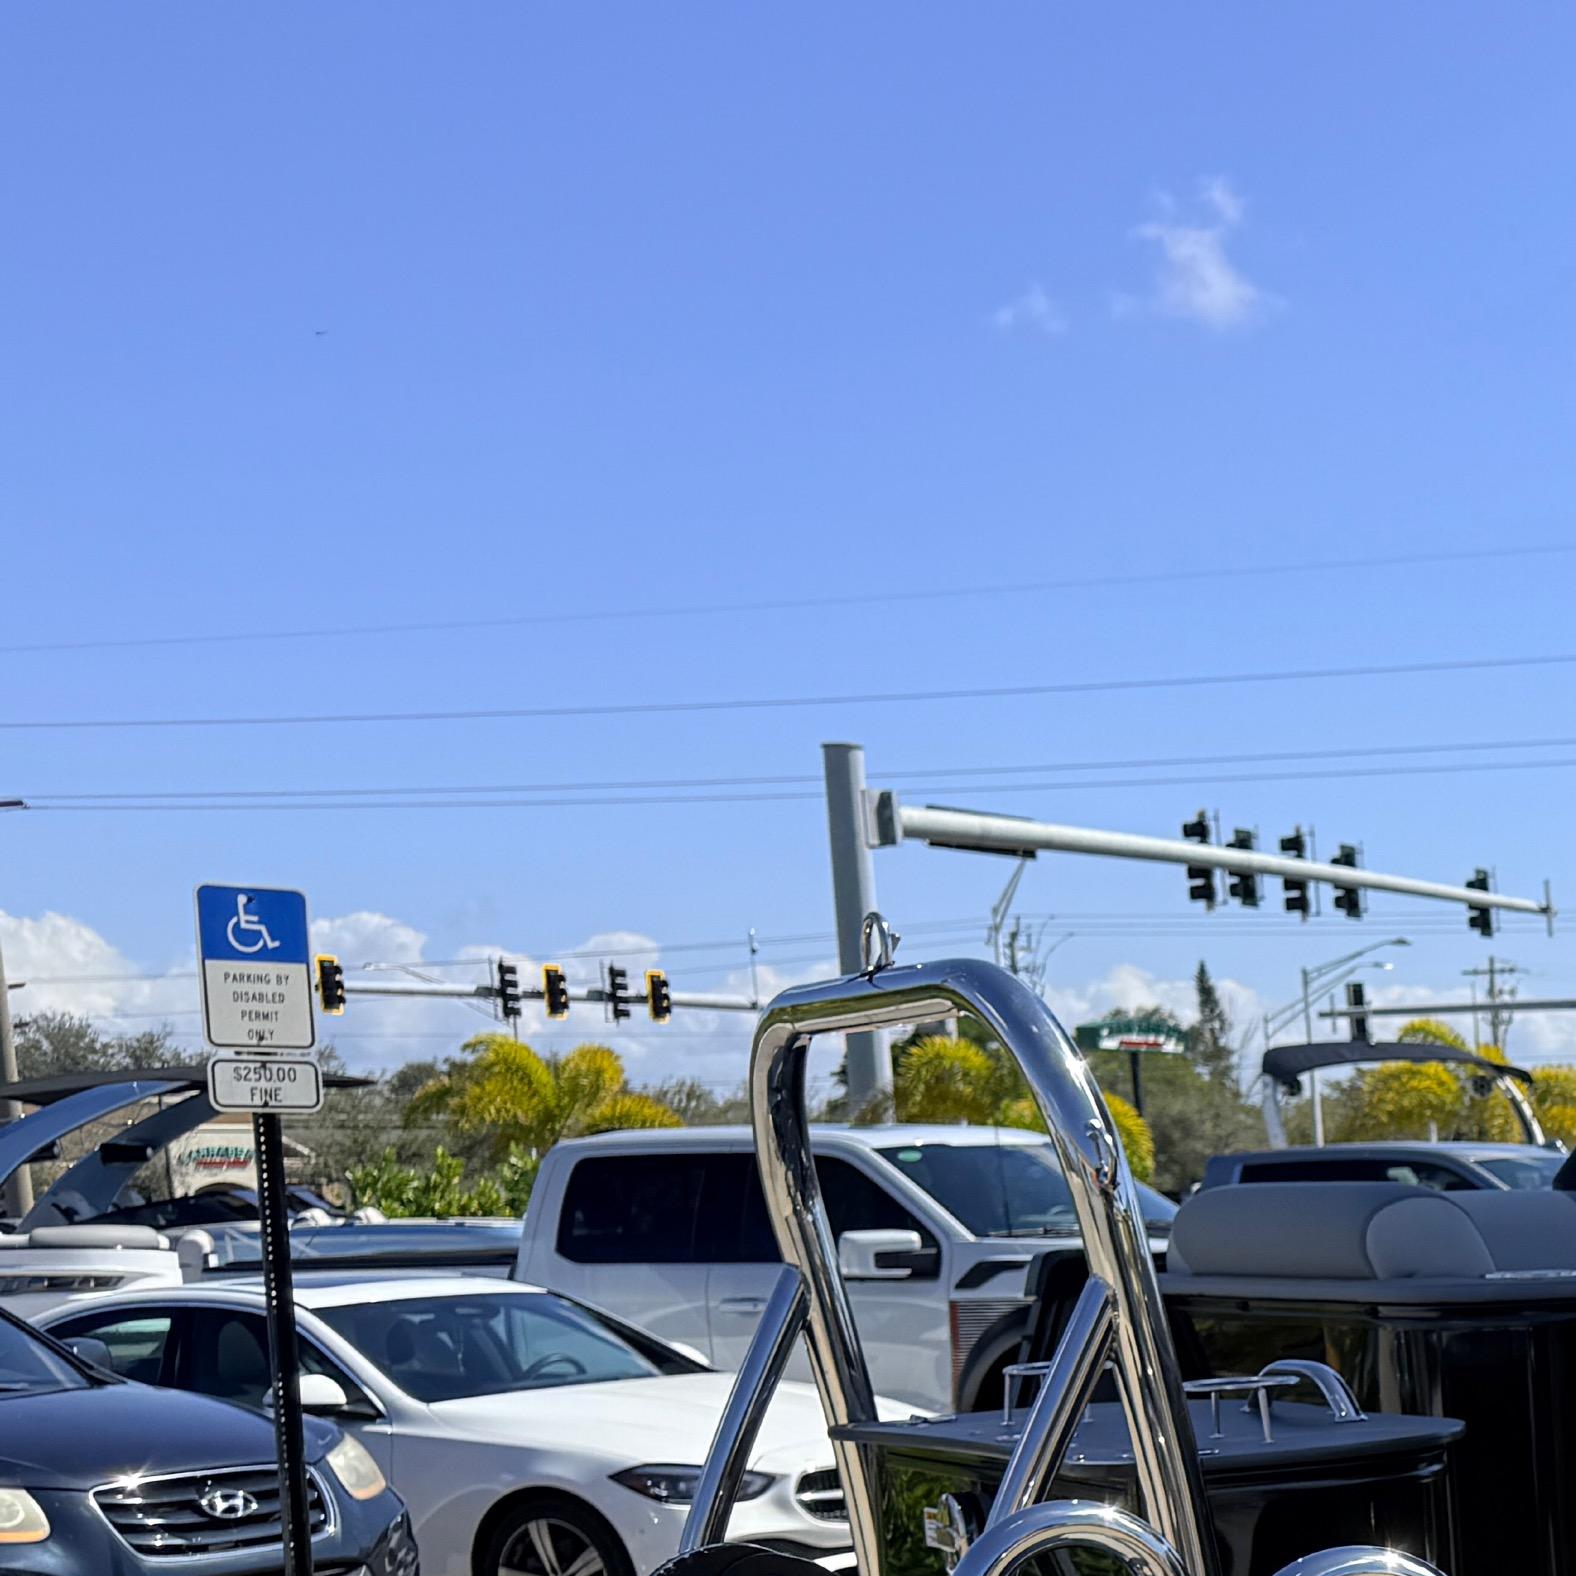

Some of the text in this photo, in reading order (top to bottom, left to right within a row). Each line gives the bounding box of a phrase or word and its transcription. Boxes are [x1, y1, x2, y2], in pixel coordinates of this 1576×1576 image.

[224, 972, 289, 986] PARKING BY
[232, 991, 285, 1004] DISABLED
[241, 1010, 278, 1022] PERMIT
[247, 1029, 274, 1041] ONLY
[233, 1066, 297, 1083] $250.00
[250, 1087, 282, 1103] FINE
